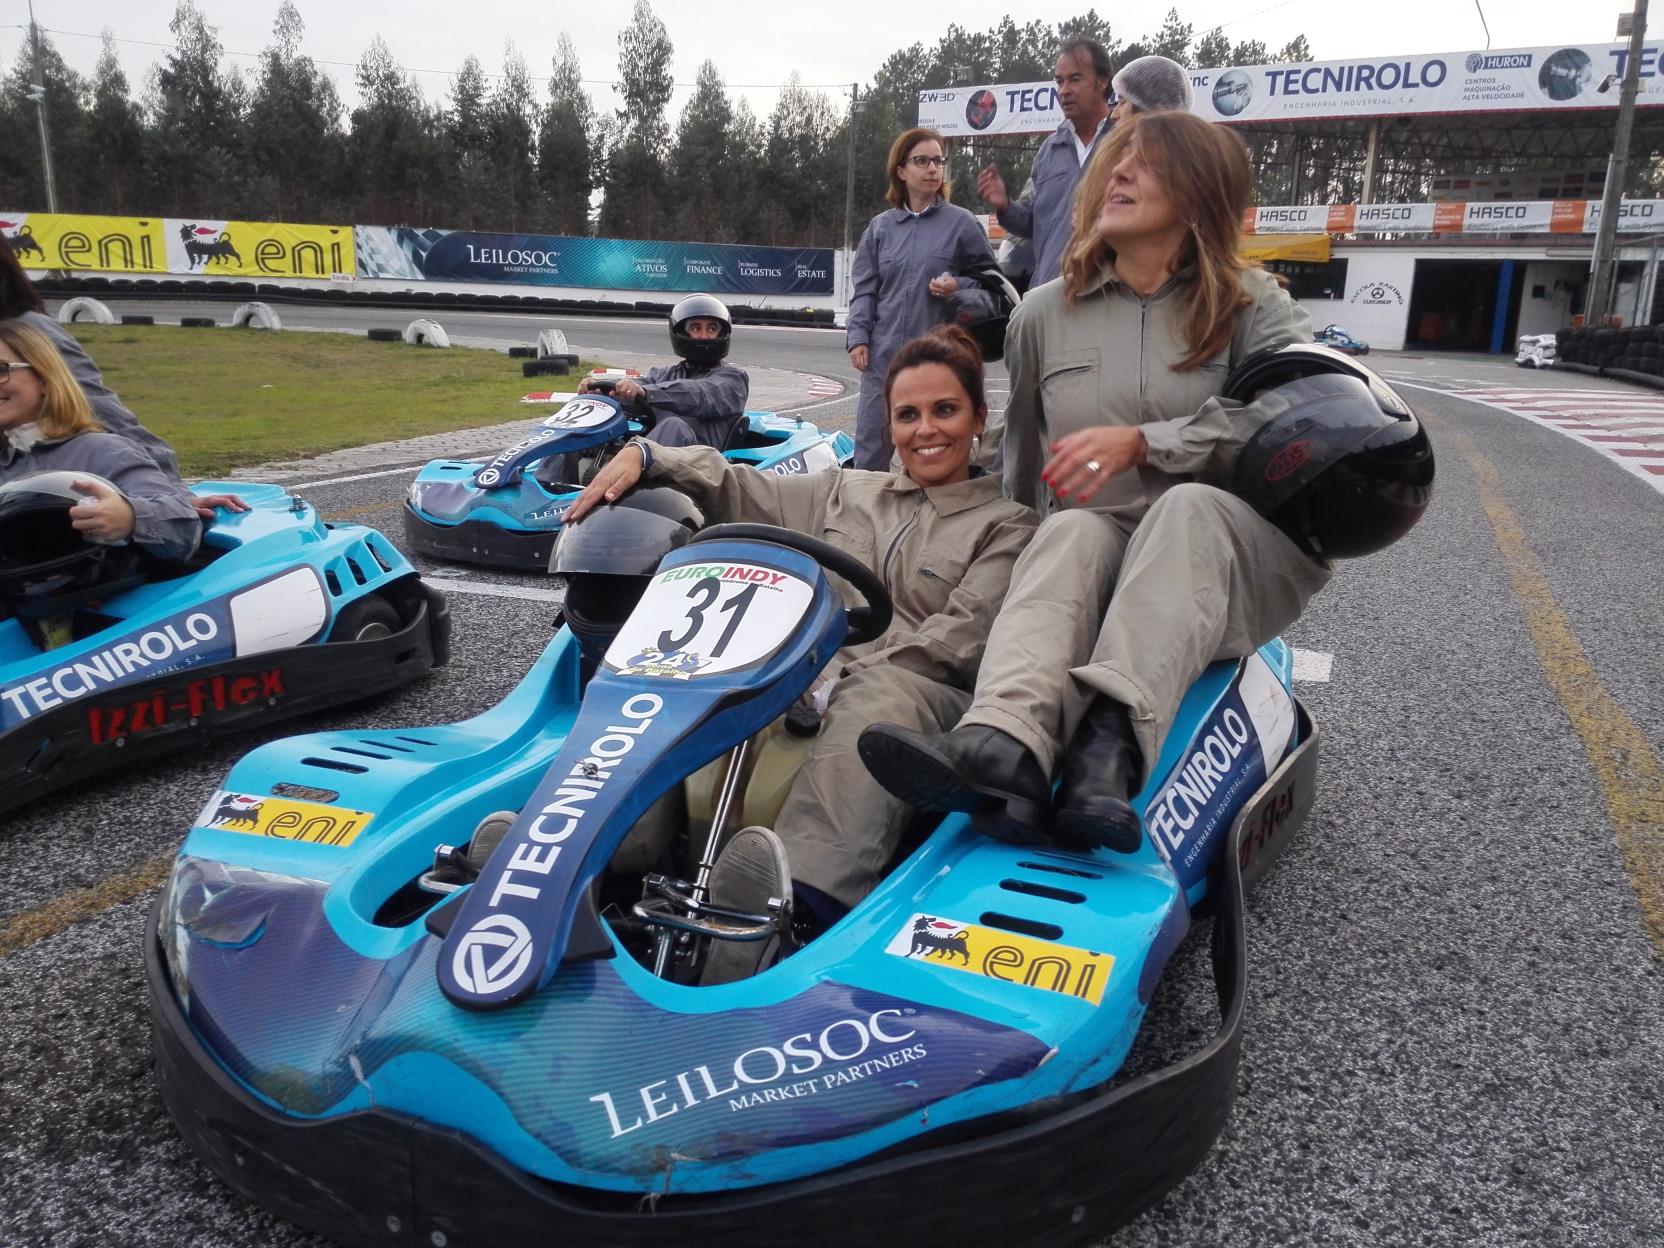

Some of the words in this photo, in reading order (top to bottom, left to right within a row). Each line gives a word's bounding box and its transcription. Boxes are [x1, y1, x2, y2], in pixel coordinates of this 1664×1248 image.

[1487, 55, 1529, 68] HURON
[1190, 75, 1209, 87] nc
[1265, 59, 1447, 96] TECNIROLO
[1481, 92, 1525, 100] VELOCIDADE
[1283, 101, 1337, 110] ENGENHARIA
[1260, 210, 1308, 222] HASCO
[1359, 208, 1412, 220] HASCO
[1469, 206, 1527, 219] HASCO
[1590, 204, 1654, 217] HSCO
[58, 221, 153, 269] eni
[255, 229, 341, 274] eni
[635, 264, 668, 273] ATIVOS
[686, 265, 723, 275] FINANCE
[740, 267, 782, 277] LOGISTICS
[797, 269, 826, 278] ESTATE
[554, 404, 595, 424] 32
[531, 506, 571, 520] LEIL
[659, 566, 789, 585] EUROINDY
[657, 576, 760, 658] 31
[2, 612, 218, 719] TECNIROLO
[637, 652, 686, 668] 24
[1150, 708, 1248, 862] TECNIROLO
[488, 692, 664, 907] TECNIROLO
[265, 811, 364, 845] eni
[1184, 818, 1217, 867] ENGENHARIA
[982, 943, 1102, 1000] eni
[728, 1078, 818, 1112] MARKET
[823, 1043, 928, 1089] PARTNERS
